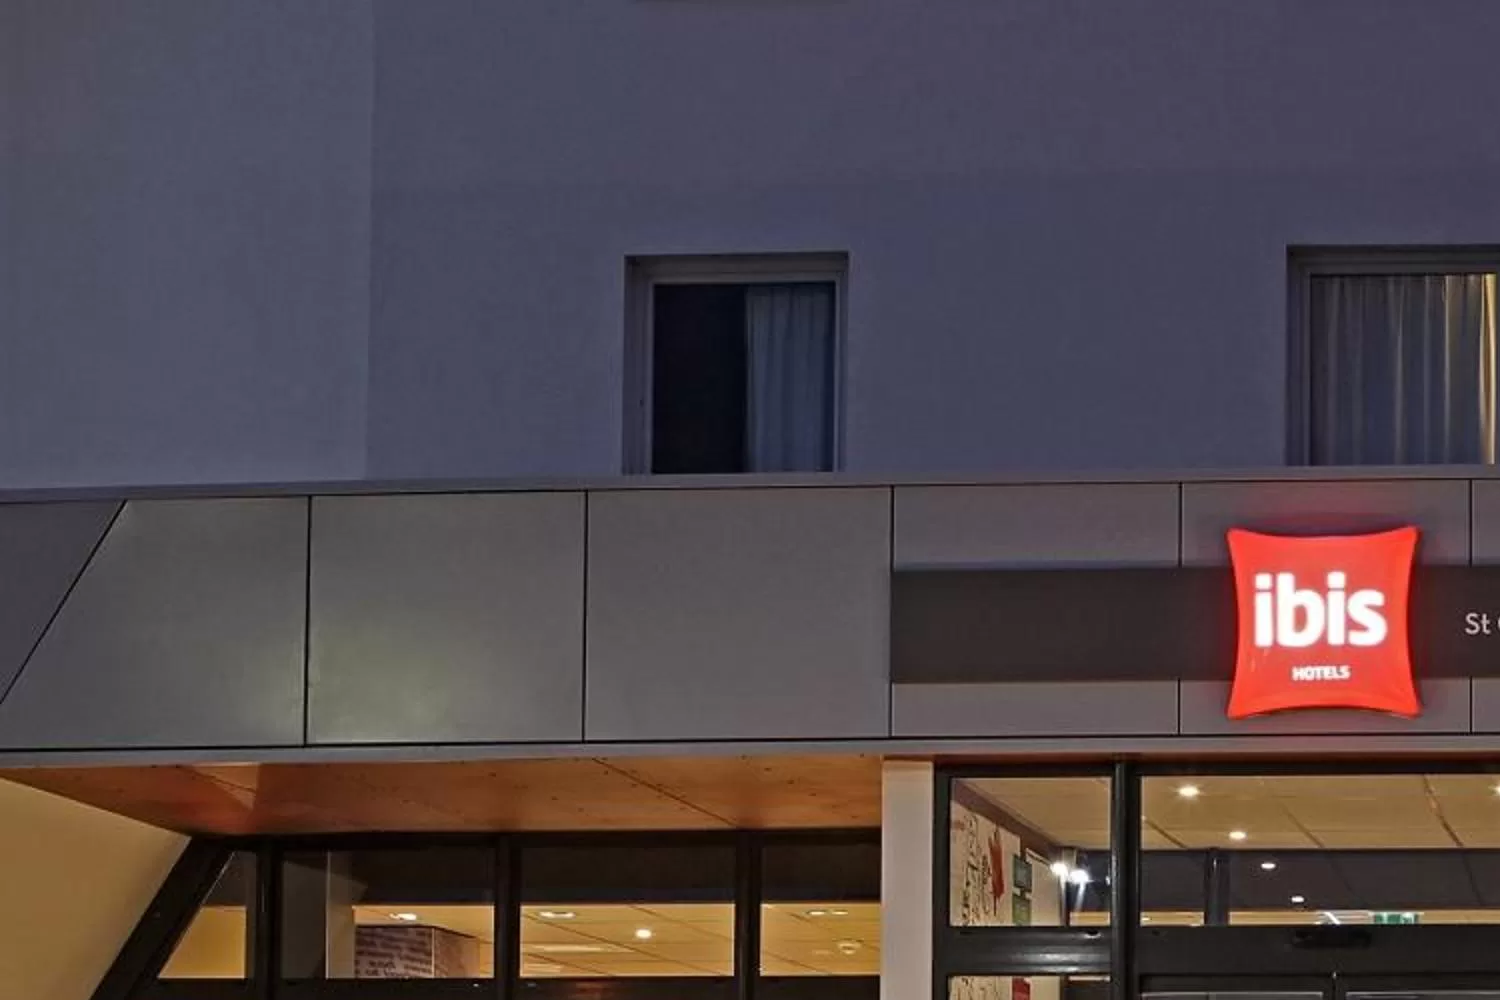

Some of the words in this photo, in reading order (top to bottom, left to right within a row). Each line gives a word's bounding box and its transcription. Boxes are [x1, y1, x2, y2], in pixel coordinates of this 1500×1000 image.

[1254, 571, 1387, 647] ibis
[1464, 612, 1491, 635] St
[1292, 665, 1350, 680] HOTELS
